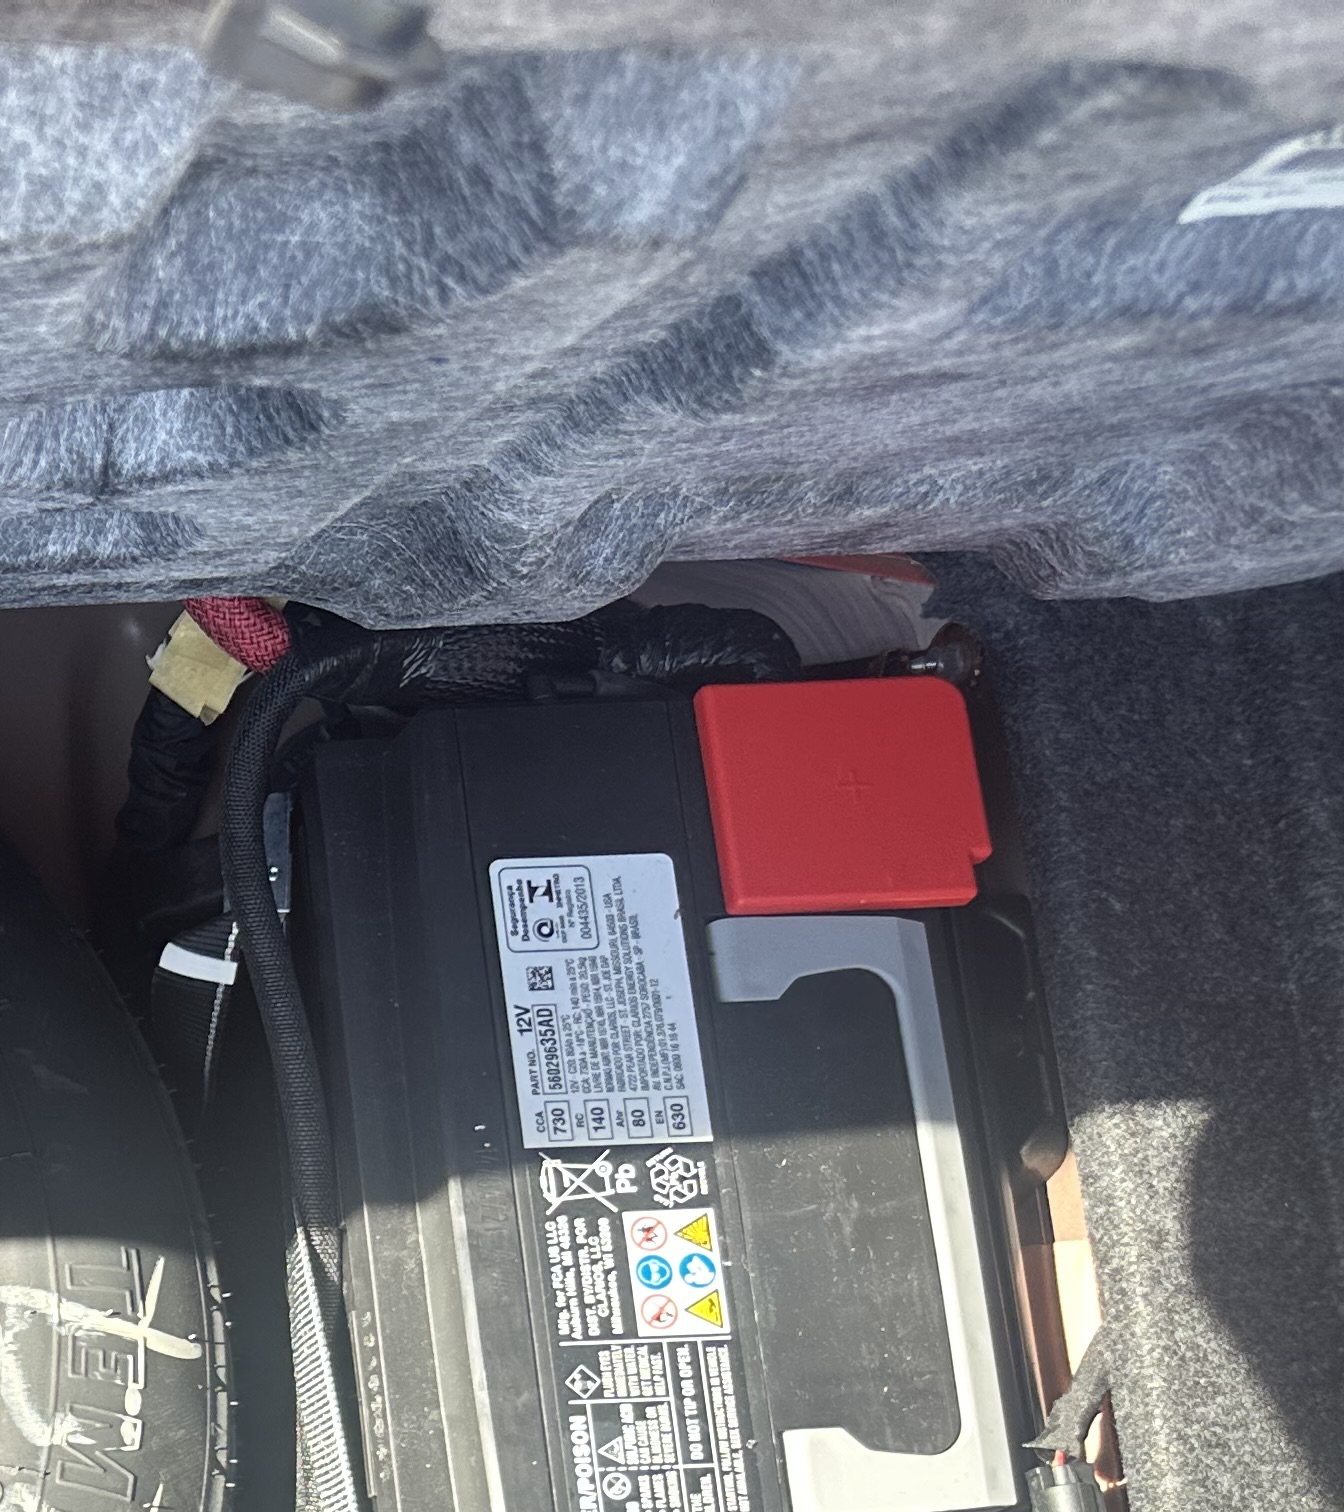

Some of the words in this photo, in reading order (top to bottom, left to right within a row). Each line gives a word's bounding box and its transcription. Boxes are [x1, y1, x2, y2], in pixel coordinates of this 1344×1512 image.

[504, 885, 520, 936] Segurança
[514, 878, 532, 941] Desempenho
[572, 876, 592, 939] 004435/2013
[602, 892, 614, 908] USA
[614, 897, 627, 922] BRASIL
[628, 913, 641, 939] BRASIL
[618, 923, 632, 964] SOLUTIONS
[632, 945, 643, 954] SP
[601, 969, 612, 981] JOE
[623, 965, 636, 994] ENERGY
[634, 960, 649, 1000] SOROCABA
[570, 997, 580, 1009] 140
[604, 996, 615, 1008] LLC
[627, 996, 641, 1027] CLARIOS
[513, 1004, 533, 1036] 12V
[666, 1022, 677, 1031] 44
[535, 1007, 563, 1090] 56029635AD
[620, 1025, 633, 1052] STREET
[526, 1048, 537, 1066] NO.
[589, 1060, 600, 1070] DE
[623, 1053, 636, 1072] PEAR
[634, 1047, 649, 1091] IMPORTADO
[528, 1068, 540, 1095] PART
[568, 1079, 580, 1093] 12V
[590, 1071, 603, 1092] LIVRE
[534, 1110, 545, 1132] CCA
[550, 1107, 567, 1135] 730
[574, 1113, 585, 1127] RC
[589, 1106, 607, 1132] 140
[614, 1109, 625, 1127] Ahr
[630, 1108, 645, 1127] 80
[653, 1109, 664, 1124] EN
[669, 1102, 686, 1130] 630
[613, 1163, 637, 1193] Pb
[543, 1221, 559, 1244] LLC
[572, 1217, 588, 1243] POR
[547, 1246, 561, 1263] US
[559, 1251, 573, 1265] MI
[587, 1235, 601, 1258] LLC
[601, 1253, 615, 1269] WI
[549, 1264, 564, 1288] FCA
[575, 1245, 596, 1303] BY/DISTR.
[552, 1289, 566, 1307] for
[590, 1261, 610, 1316] CLARIOS,
[555, 1309, 572, 1335] Mfg.
[564, 1297, 583, 1339] Auburn
[584, 1305, 601, 1335] DIST.
[598, 1350, 612, 1371] EYES
[610, 1344, 628, 1397] IMMEDIATELY
[636, 1344, 652, 1379] MEDICAL
[649, 1351, 664, 1374] FAST.
[675, 1343, 693, 1377] OPEN.
[704, 1346, 719, 1376] VEHICLE
[600, 1371, 615, 1397] FLUSH
[626, 1375, 640, 1396] WITH
[640, 1380, 654, 1396] GET
[652, 1375, 666, 1395] HELP
[680, 1379, 695, 1396] OR
[618, 1403, 634, 1423] ACID
[682, 1397, 698, 1416] TIP
[709, 1386, 728, 1439] INSTRUCTIONS
[723, 1395, 739, 1427] SERVICE
[634, 1420, 649, 1446] CAUSE
[646, 1419, 663, 1464] BLINDNESS
[685, 1417, 702, 1441] NOT
[728, 1428, 742, 1448] SEEK
[638, 1447, 652, 1464] CAN
[660, 1432, 676, 1463] SEVERE
[688, 1442, 704, 1460] DO
[717, 1440, 733, 1471] FOLLOW
[637, 1474, 653, 1508] SPARKS
[651, 1473, 667, 1508] FLAMES
[664, 1469, 682, 1507] SMOKING
[689, 1492, 703, 1512] THE
[736, 1495, 750, 1512] NOT
